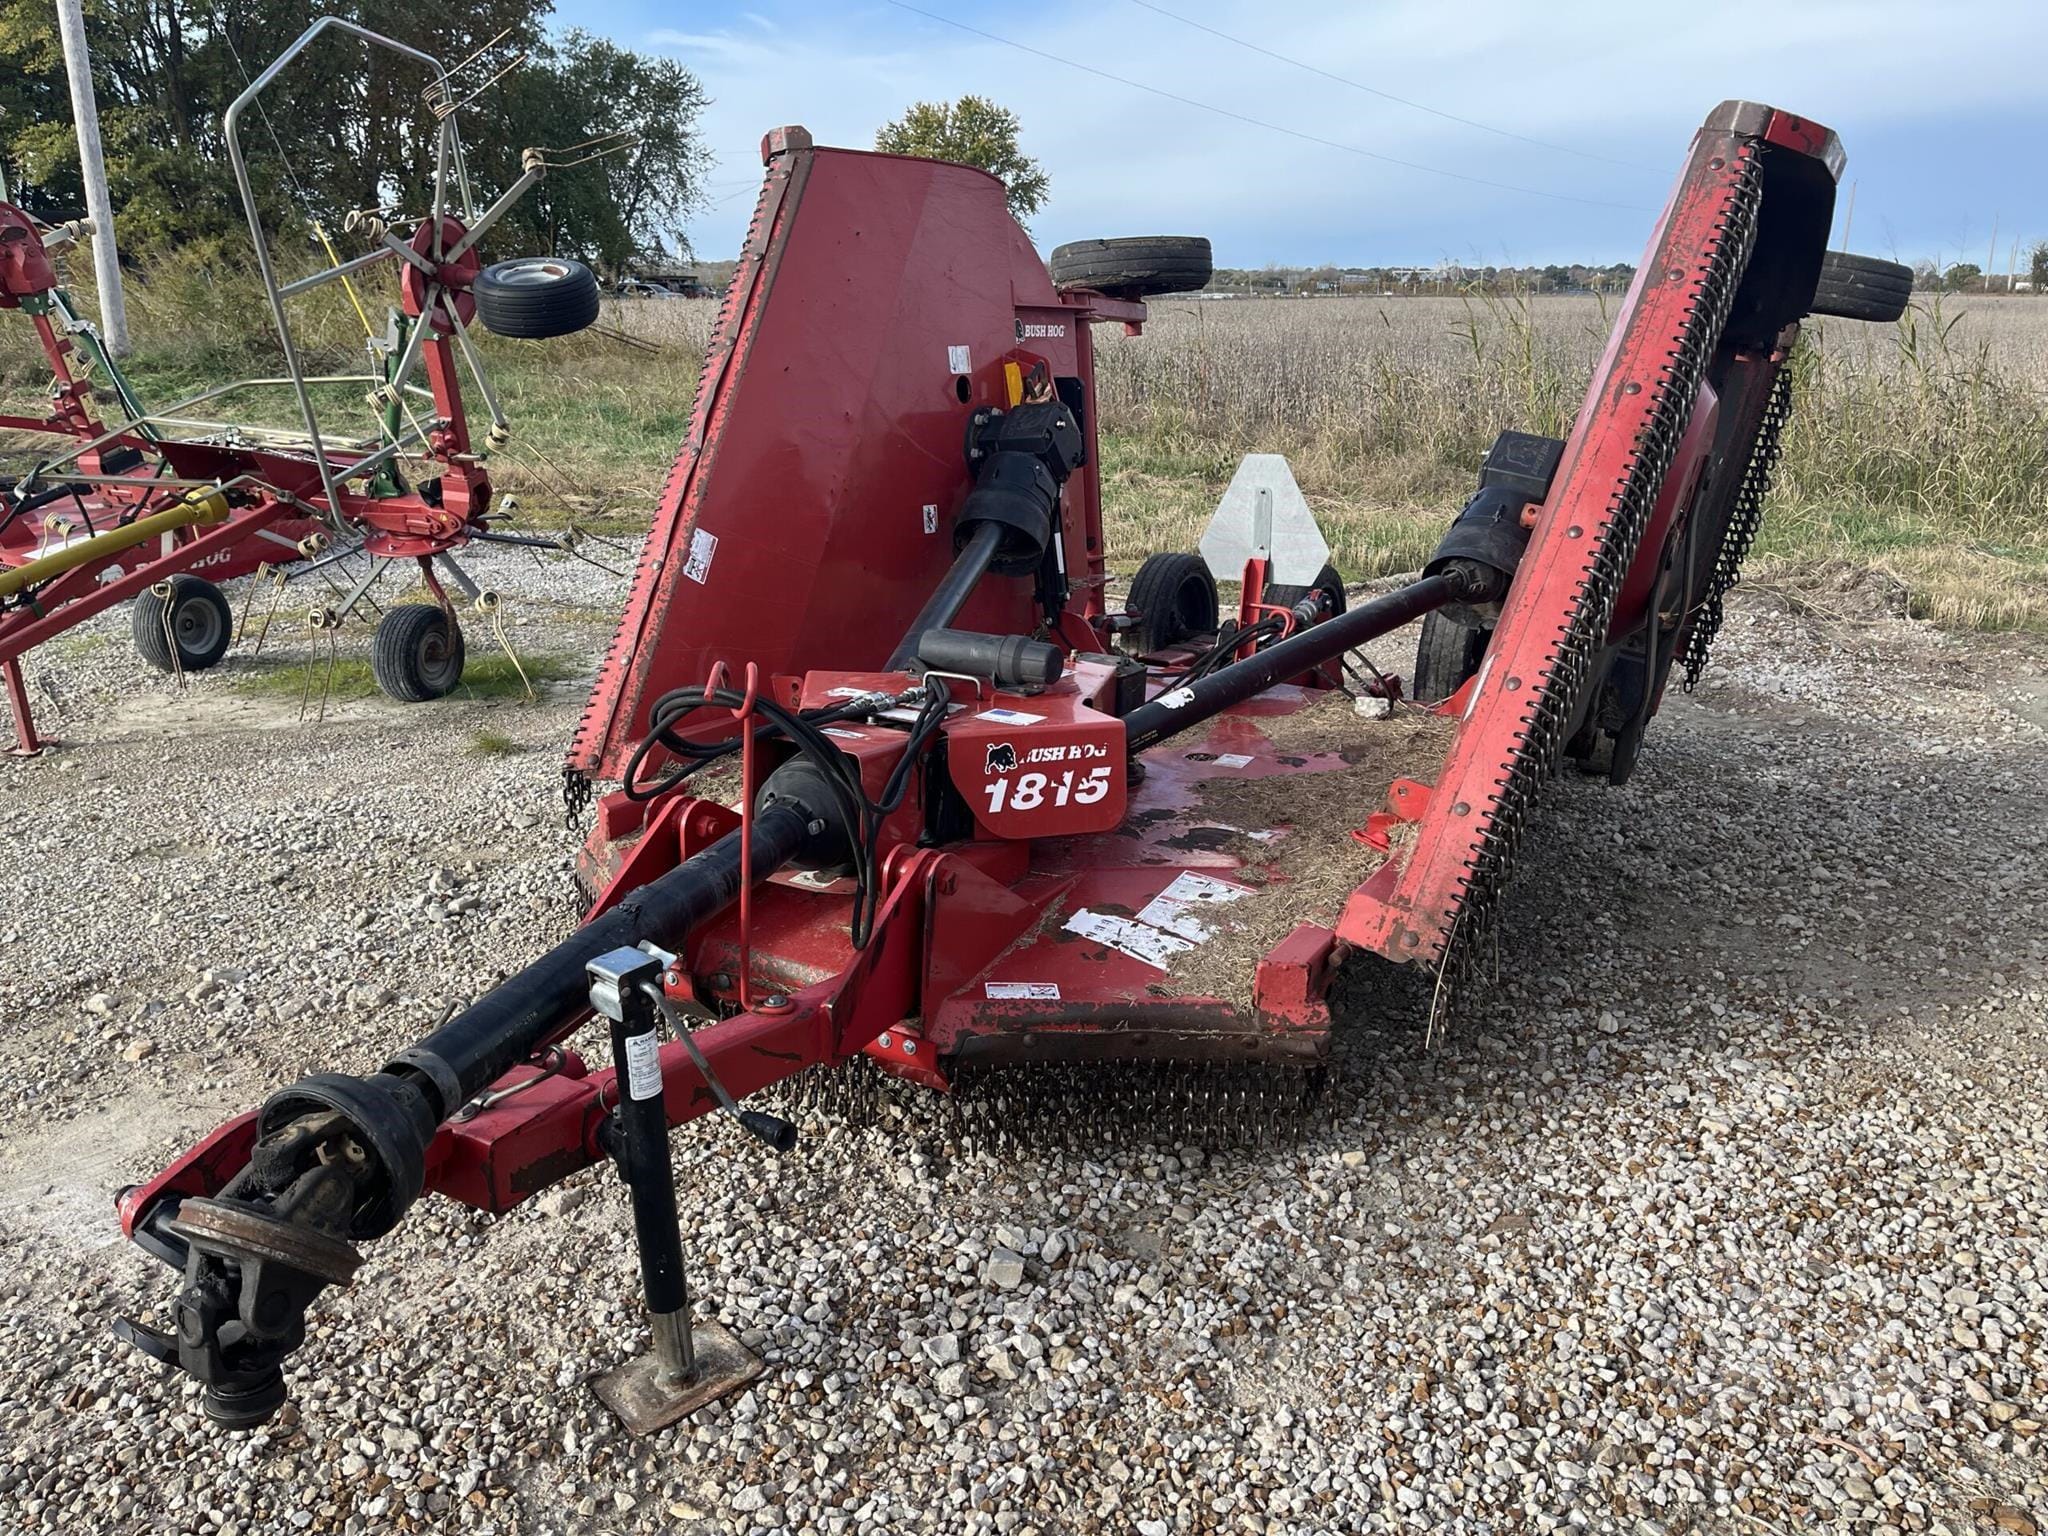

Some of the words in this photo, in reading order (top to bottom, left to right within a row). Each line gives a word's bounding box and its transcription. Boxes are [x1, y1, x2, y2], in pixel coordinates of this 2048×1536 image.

[1025, 325, 1046, 337] BUSH
[1047, 325, 1065, 337] HOG
[984, 767, 1112, 813] 1815
